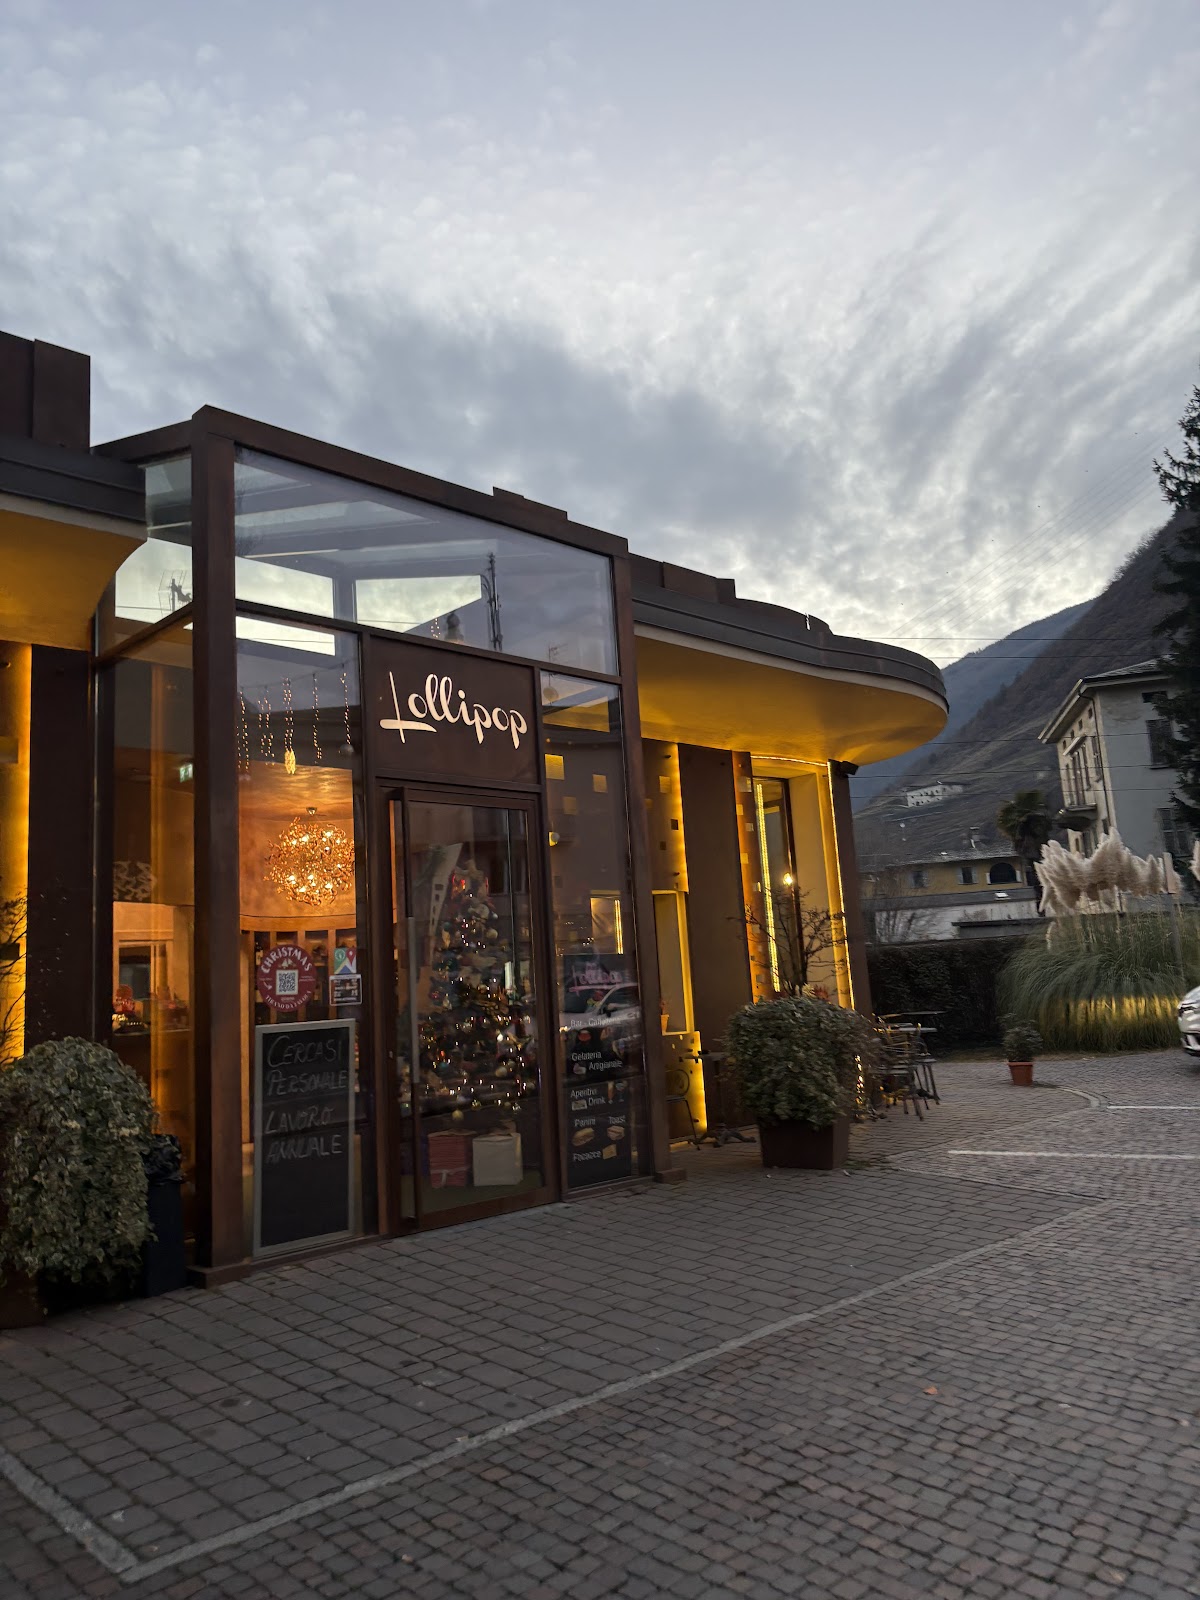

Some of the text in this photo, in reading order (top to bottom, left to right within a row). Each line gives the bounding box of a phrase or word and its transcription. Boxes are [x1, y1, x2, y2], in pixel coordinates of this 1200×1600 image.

[380, 671, 527, 749] Lollipop
[261, 947, 313, 974] CHRISTMAS
[267, 1035, 343, 1068] CERCASI
[267, 1069, 348, 1096] PERSONALE
[588, 1096, 606, 1107] Drink
[265, 1105, 335, 1135] LAVORO
[574, 1114, 626, 1127] Panini Toast
